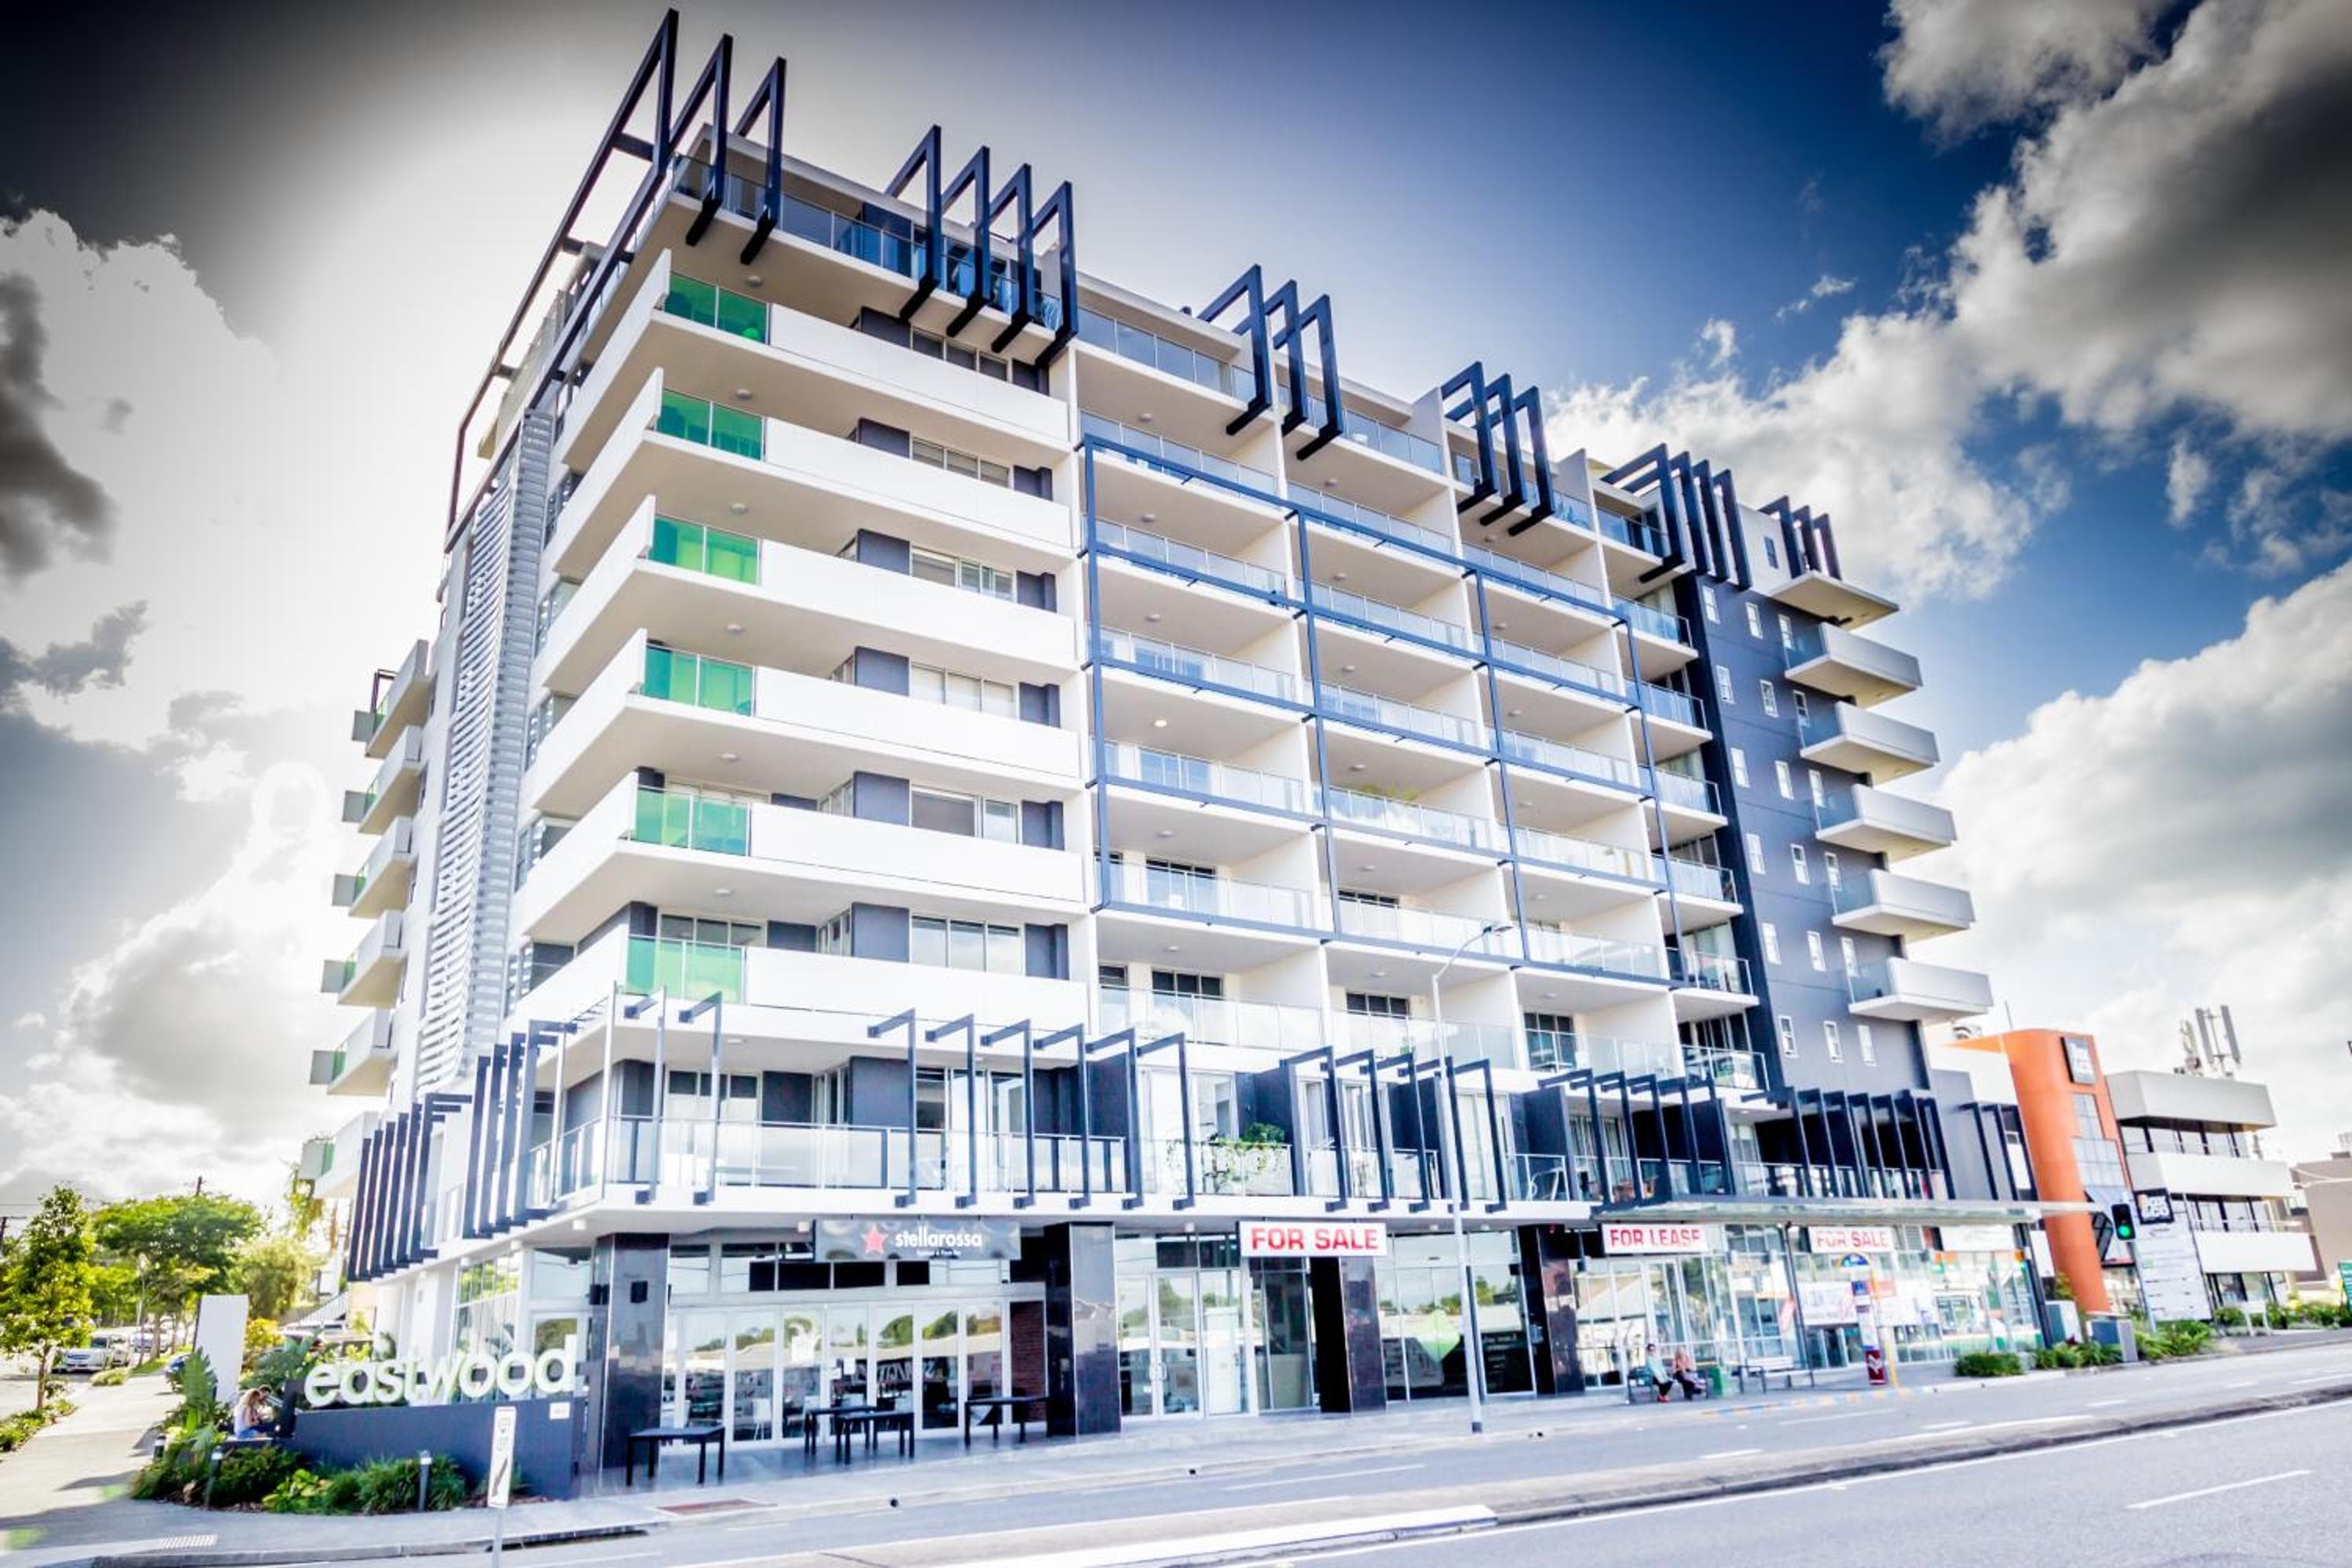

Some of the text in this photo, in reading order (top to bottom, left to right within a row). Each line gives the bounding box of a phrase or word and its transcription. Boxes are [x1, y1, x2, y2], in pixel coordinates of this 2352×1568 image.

[895, 1225, 982, 1247] stellarossa
[1251, 1227, 1379, 1250] FOR SALE
[1610, 1228, 1701, 1247] FOR LEASE
[1816, 1229, 1889, 1247] FOR SALE
[303, 1334, 578, 1406] eastwood
